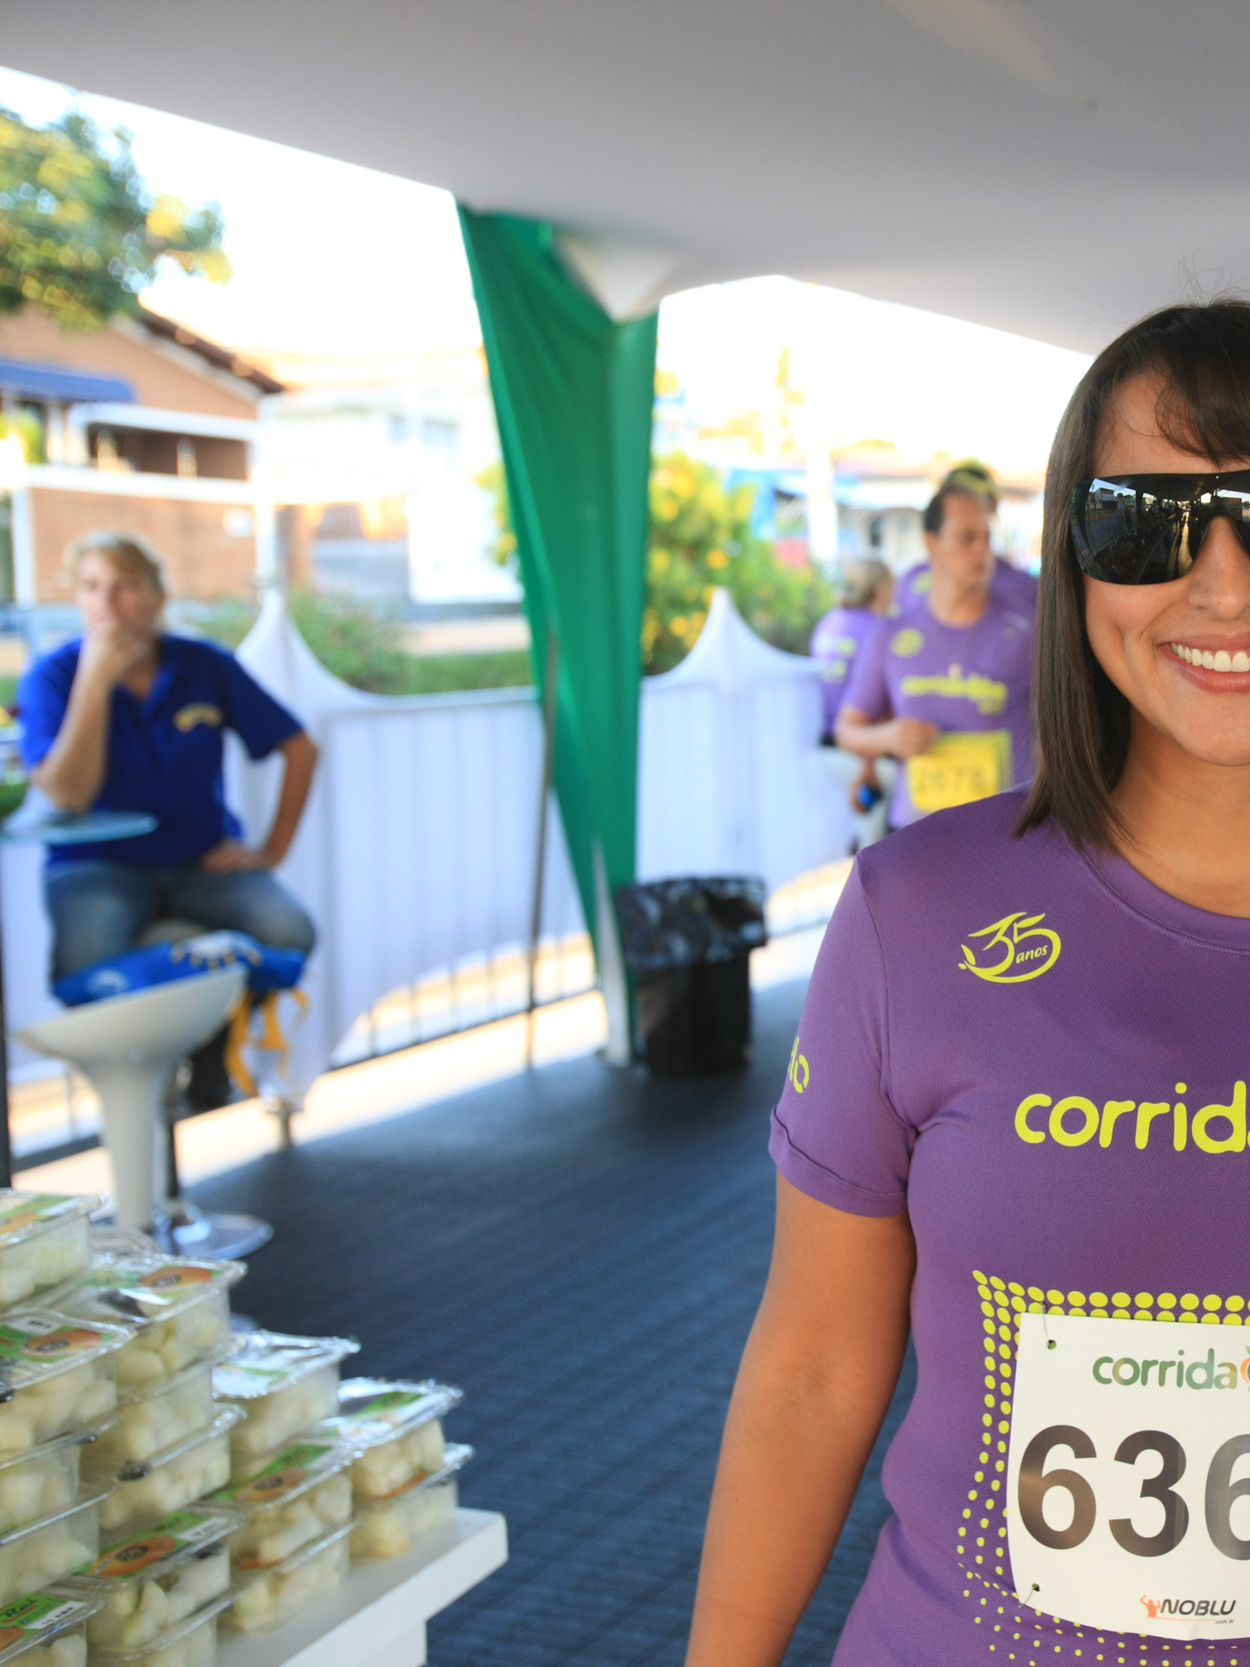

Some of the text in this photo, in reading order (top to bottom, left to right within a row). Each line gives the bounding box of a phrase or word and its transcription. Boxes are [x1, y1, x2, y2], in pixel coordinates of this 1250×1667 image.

[958, 911, 1062, 984] 35
[1016, 944, 1048, 964] anos
[1092, 1347, 1238, 1390] corrida
[1160, 1598, 1237, 1616] NOBLU
